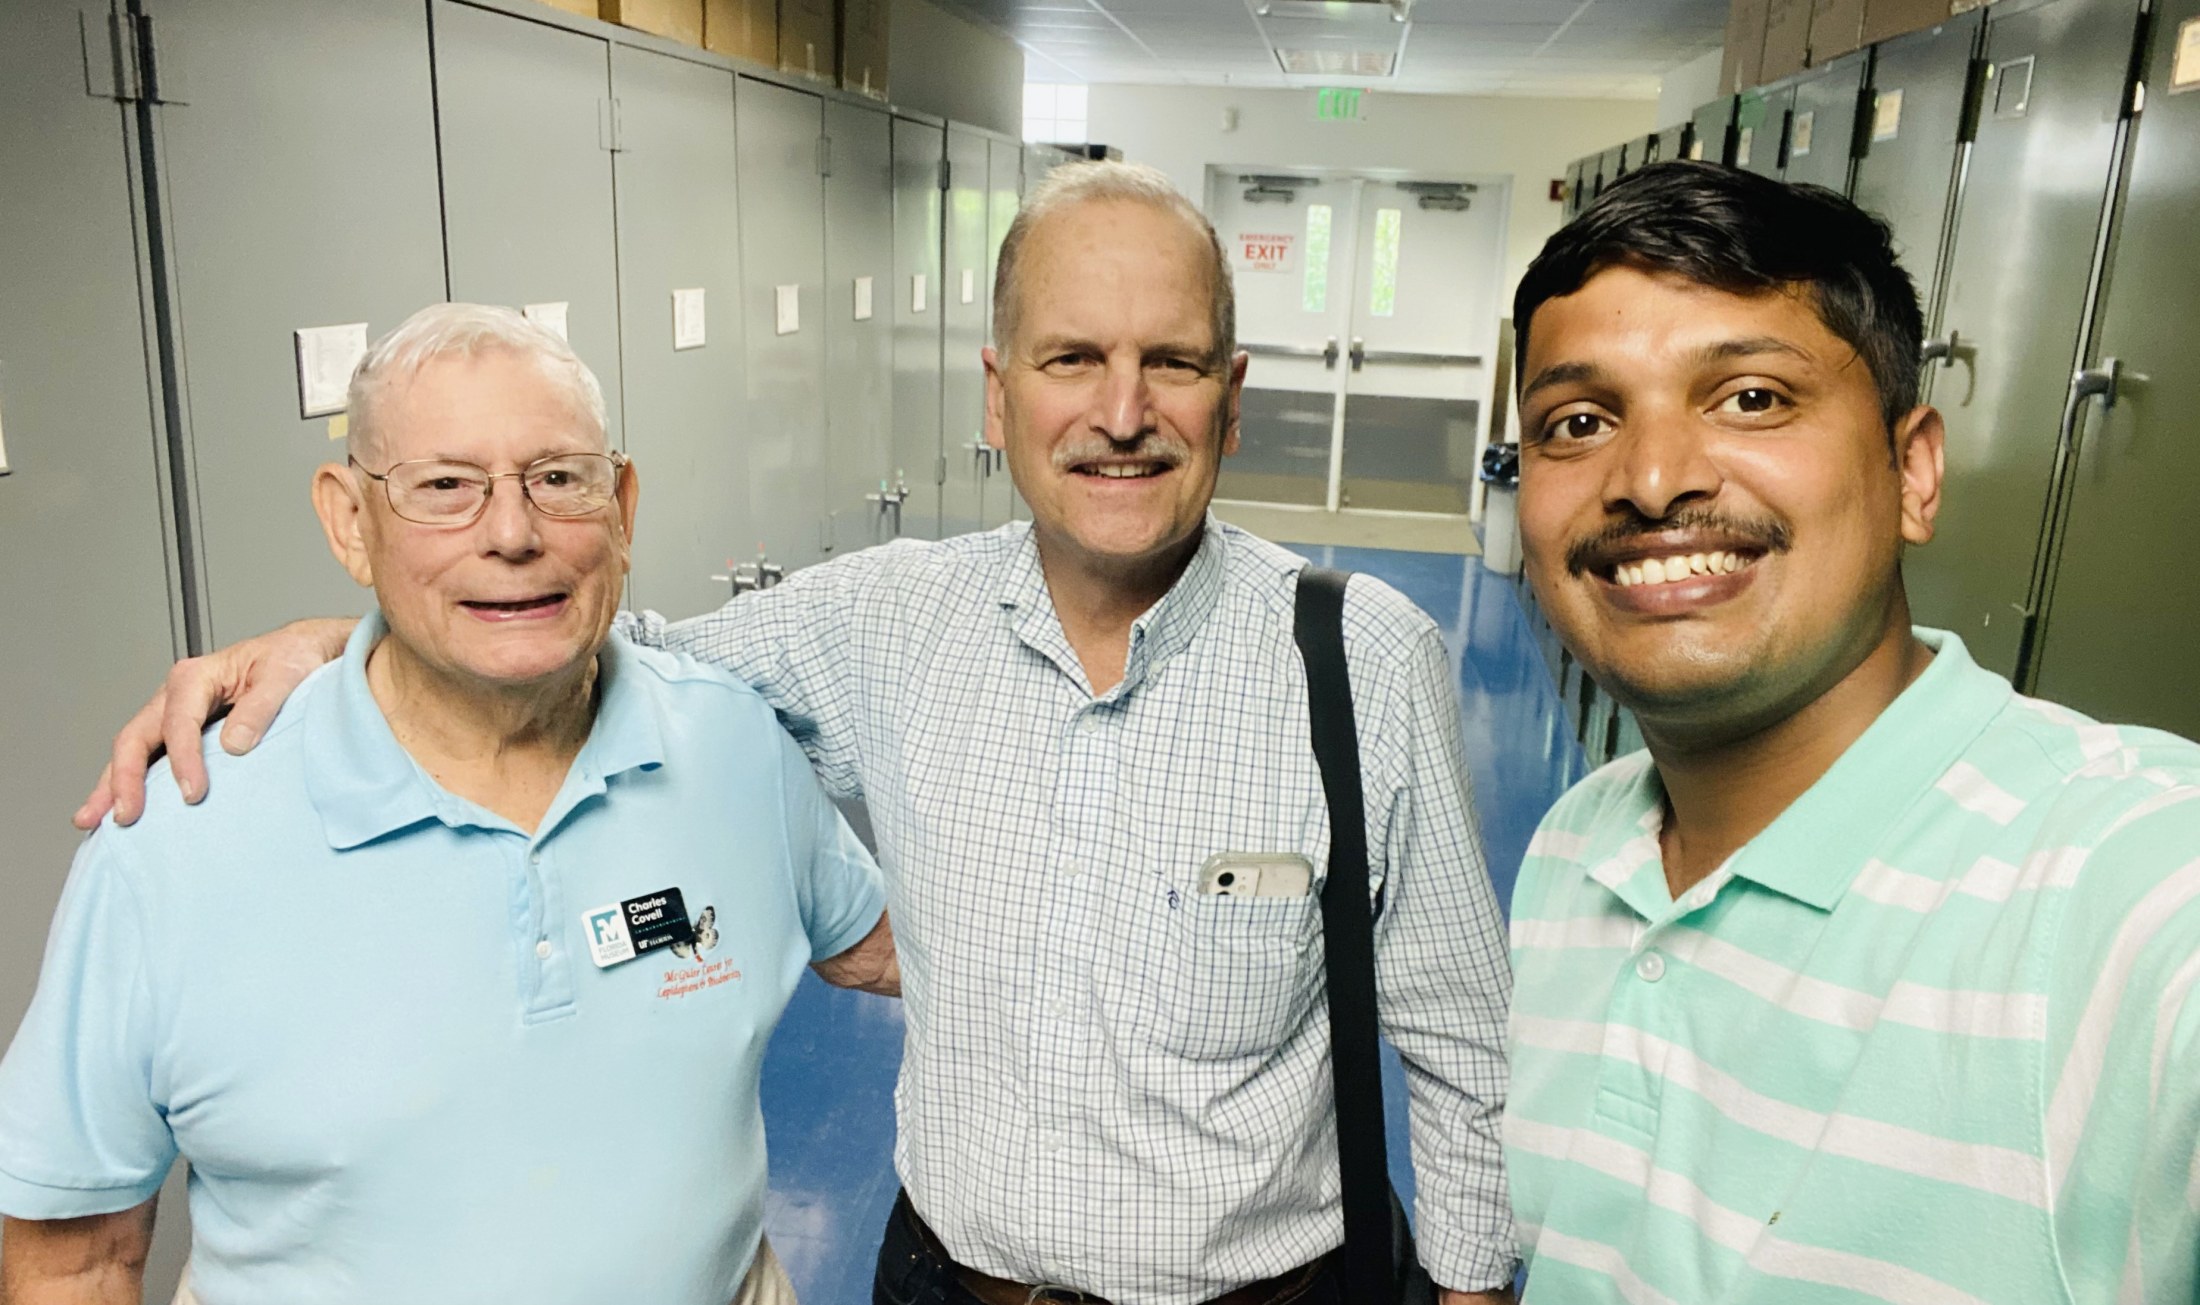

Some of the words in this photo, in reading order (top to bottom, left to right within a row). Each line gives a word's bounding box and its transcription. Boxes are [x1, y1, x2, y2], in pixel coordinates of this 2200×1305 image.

[1318, 88, 1361, 119] EXIT
[1245, 244, 1287, 261] EXIT
[628, 897, 667, 914] Charles
[631, 908, 663, 925] Covell
